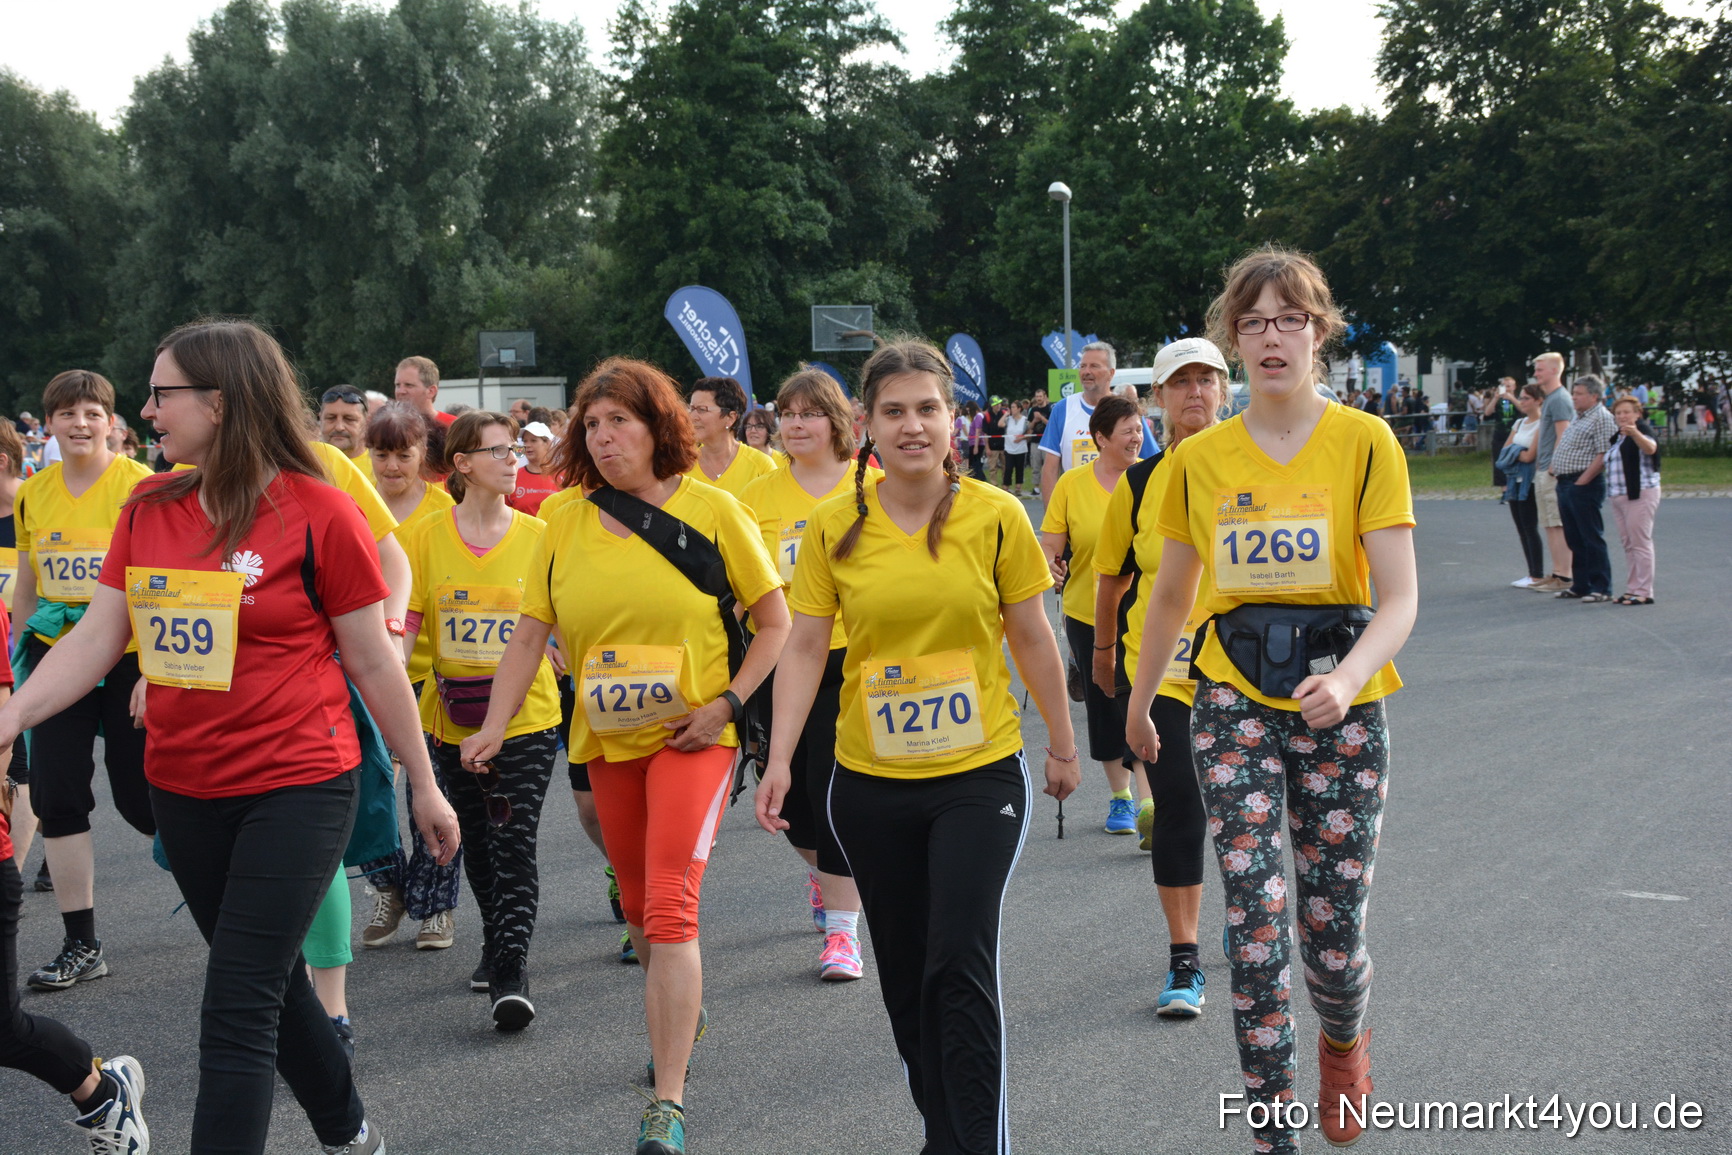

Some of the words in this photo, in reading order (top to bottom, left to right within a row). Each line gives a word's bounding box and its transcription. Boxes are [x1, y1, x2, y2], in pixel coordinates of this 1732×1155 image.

[1065, 372, 1077, 380] km
[1229, 503, 1267, 513] firmenlauf
[1223, 528, 1320, 564] 1269
[785, 543, 796, 565] 1
[43, 557, 102, 580] 1265
[1250, 572, 1273, 580] Isabell
[1274, 571, 1296, 579] Barth
[142, 588, 181, 598] firmenlauf
[240, 594, 255, 605] as
[150, 616, 213, 655] 259
[445, 617, 515, 645] 1276
[164, 661, 181, 671] Sabine
[183, 663, 205, 672] Weber
[595, 660, 628, 670] firmenlauf
[878, 675, 916, 686] firmenlauf
[590, 682, 673, 712] 1279
[640, 711, 657, 720] Haas
[877, 692, 971, 734] 1270
[906, 739, 930, 747] Marina
[931, 735, 950, 745] Klebl
[1000, 810, 1016, 818] adidas
